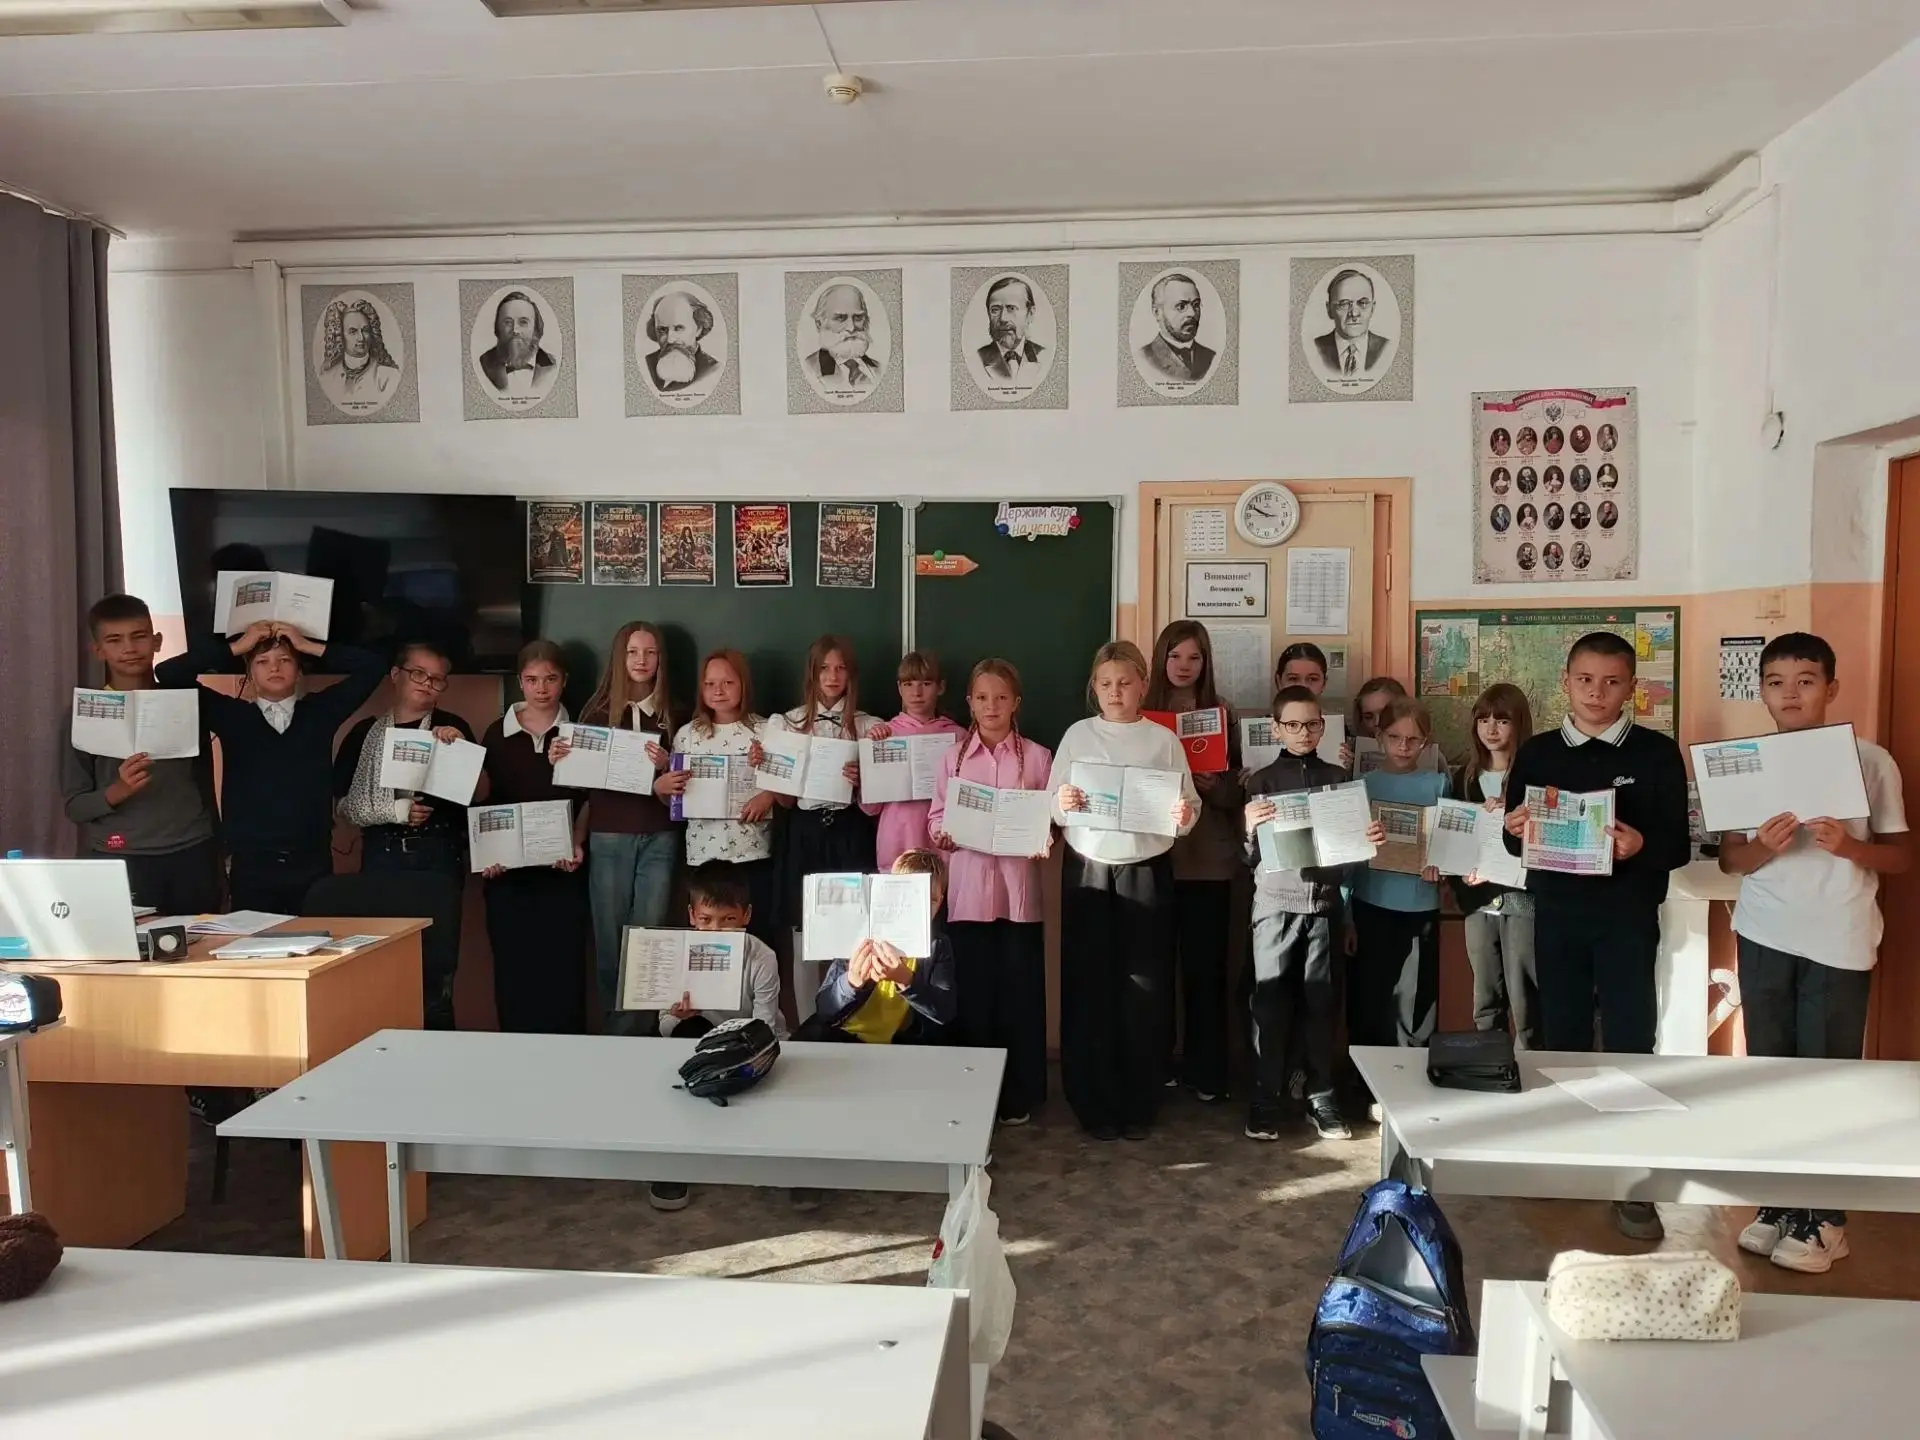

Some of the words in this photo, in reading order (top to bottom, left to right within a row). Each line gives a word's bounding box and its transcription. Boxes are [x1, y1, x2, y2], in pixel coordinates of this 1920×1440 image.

[997, 503, 1047, 522] Держим
[1030, 523, 1069, 540] успех!
[1204, 572, 1251, 581] Внимание!
[52, 902, 69, 919] hp
